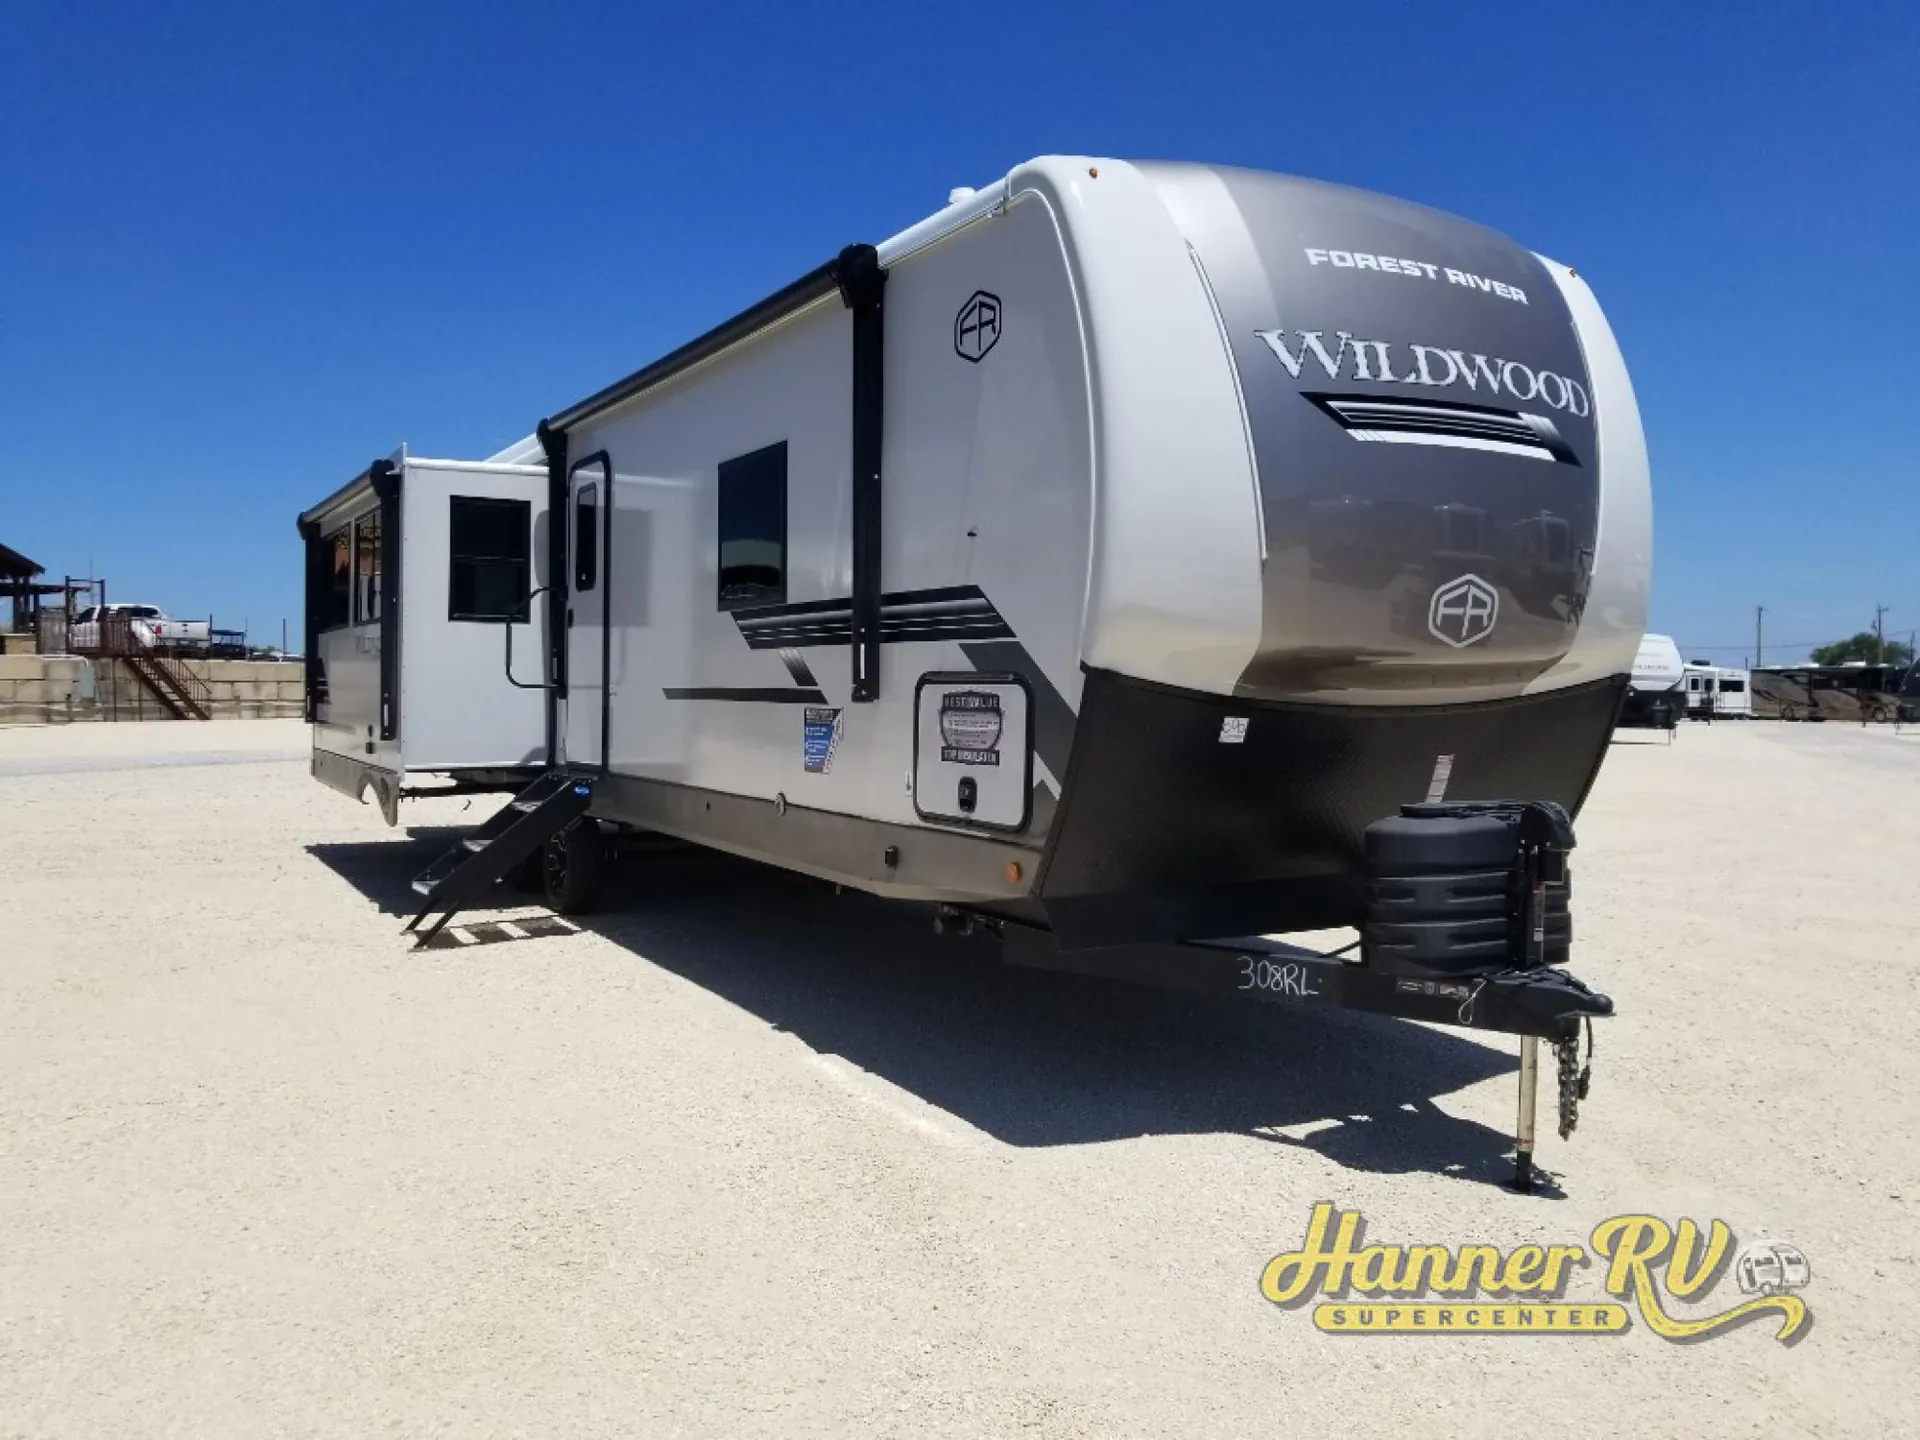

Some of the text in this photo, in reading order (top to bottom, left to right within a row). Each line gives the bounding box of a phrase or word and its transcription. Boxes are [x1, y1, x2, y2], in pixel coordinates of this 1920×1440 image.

[1304, 248, 1529, 305] FOREST RIVER
[1254, 329, 1590, 418] WILDWOOD
[1237, 956, 1319, 995] 308RL
